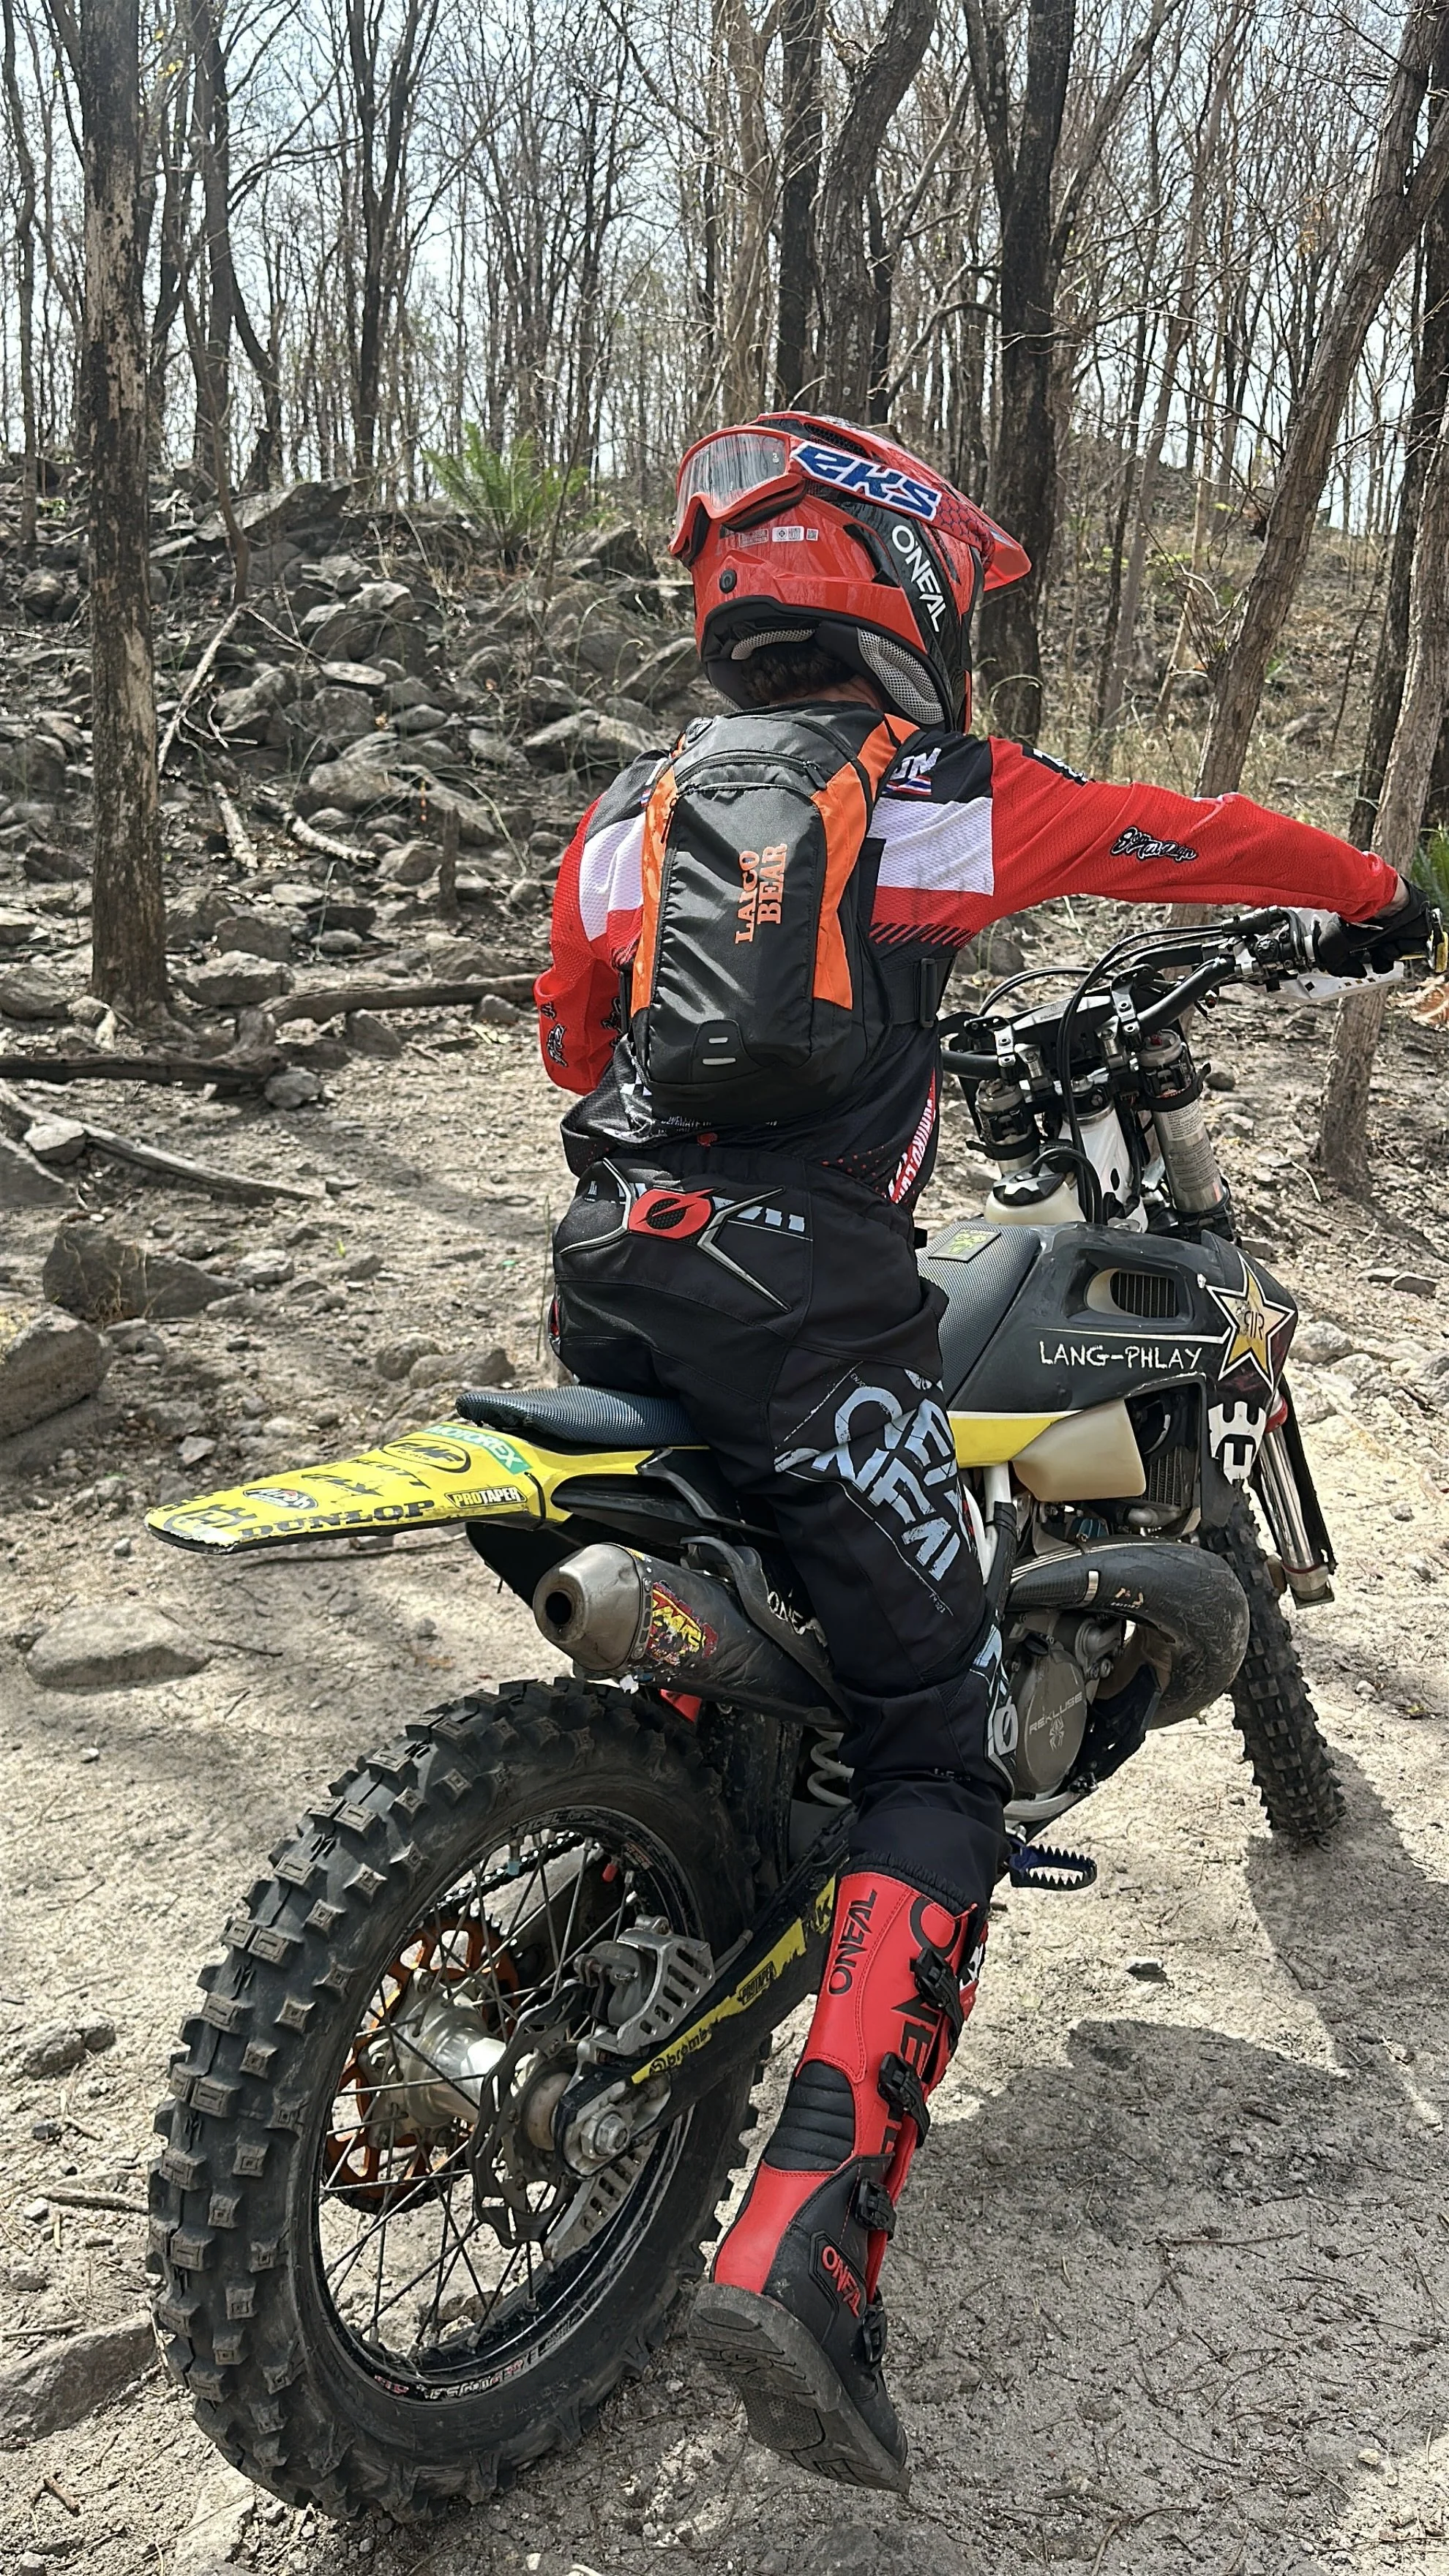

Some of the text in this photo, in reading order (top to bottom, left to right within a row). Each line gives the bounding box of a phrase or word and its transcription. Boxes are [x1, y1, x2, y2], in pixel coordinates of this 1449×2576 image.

[735, 850, 760, 945] LAICO
[757, 842, 788, 925] BEAR
[1038, 1341, 1203, 1371] LANG-PHLAY
[425, 1425, 523, 1470] MOTOREX
[238, 1499, 435, 1537] DUNLOP
[1028, 1690, 1084, 1736] REKLUSE
